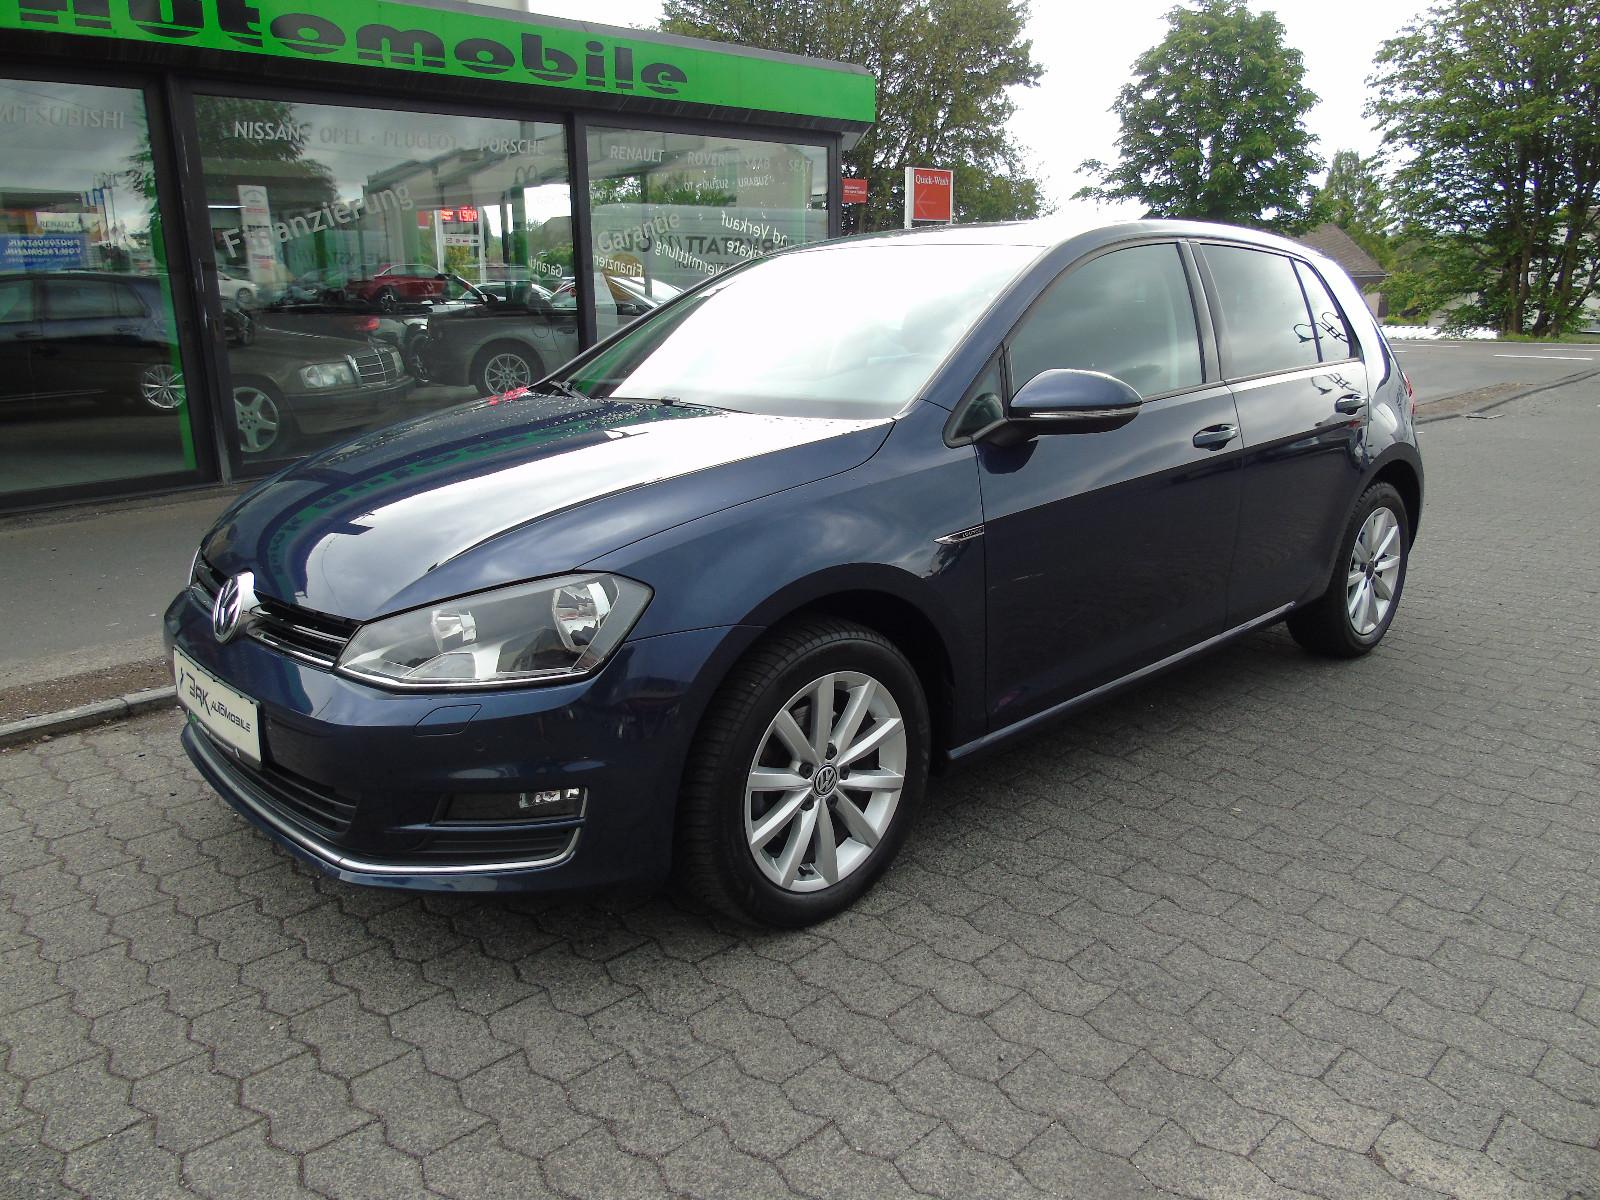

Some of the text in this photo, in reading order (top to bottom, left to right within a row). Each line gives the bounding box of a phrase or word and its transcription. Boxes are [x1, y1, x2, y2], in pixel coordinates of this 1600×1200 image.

[233, 121, 301, 142] NISSAN
[319, 127, 364, 145] OPEL
[479, 138, 545, 155] PORSCHE
[609, 145, 665, 163] RENAULT
[687, 151, 725, 167] ROVER
[597, 210, 681, 253] Garantie
